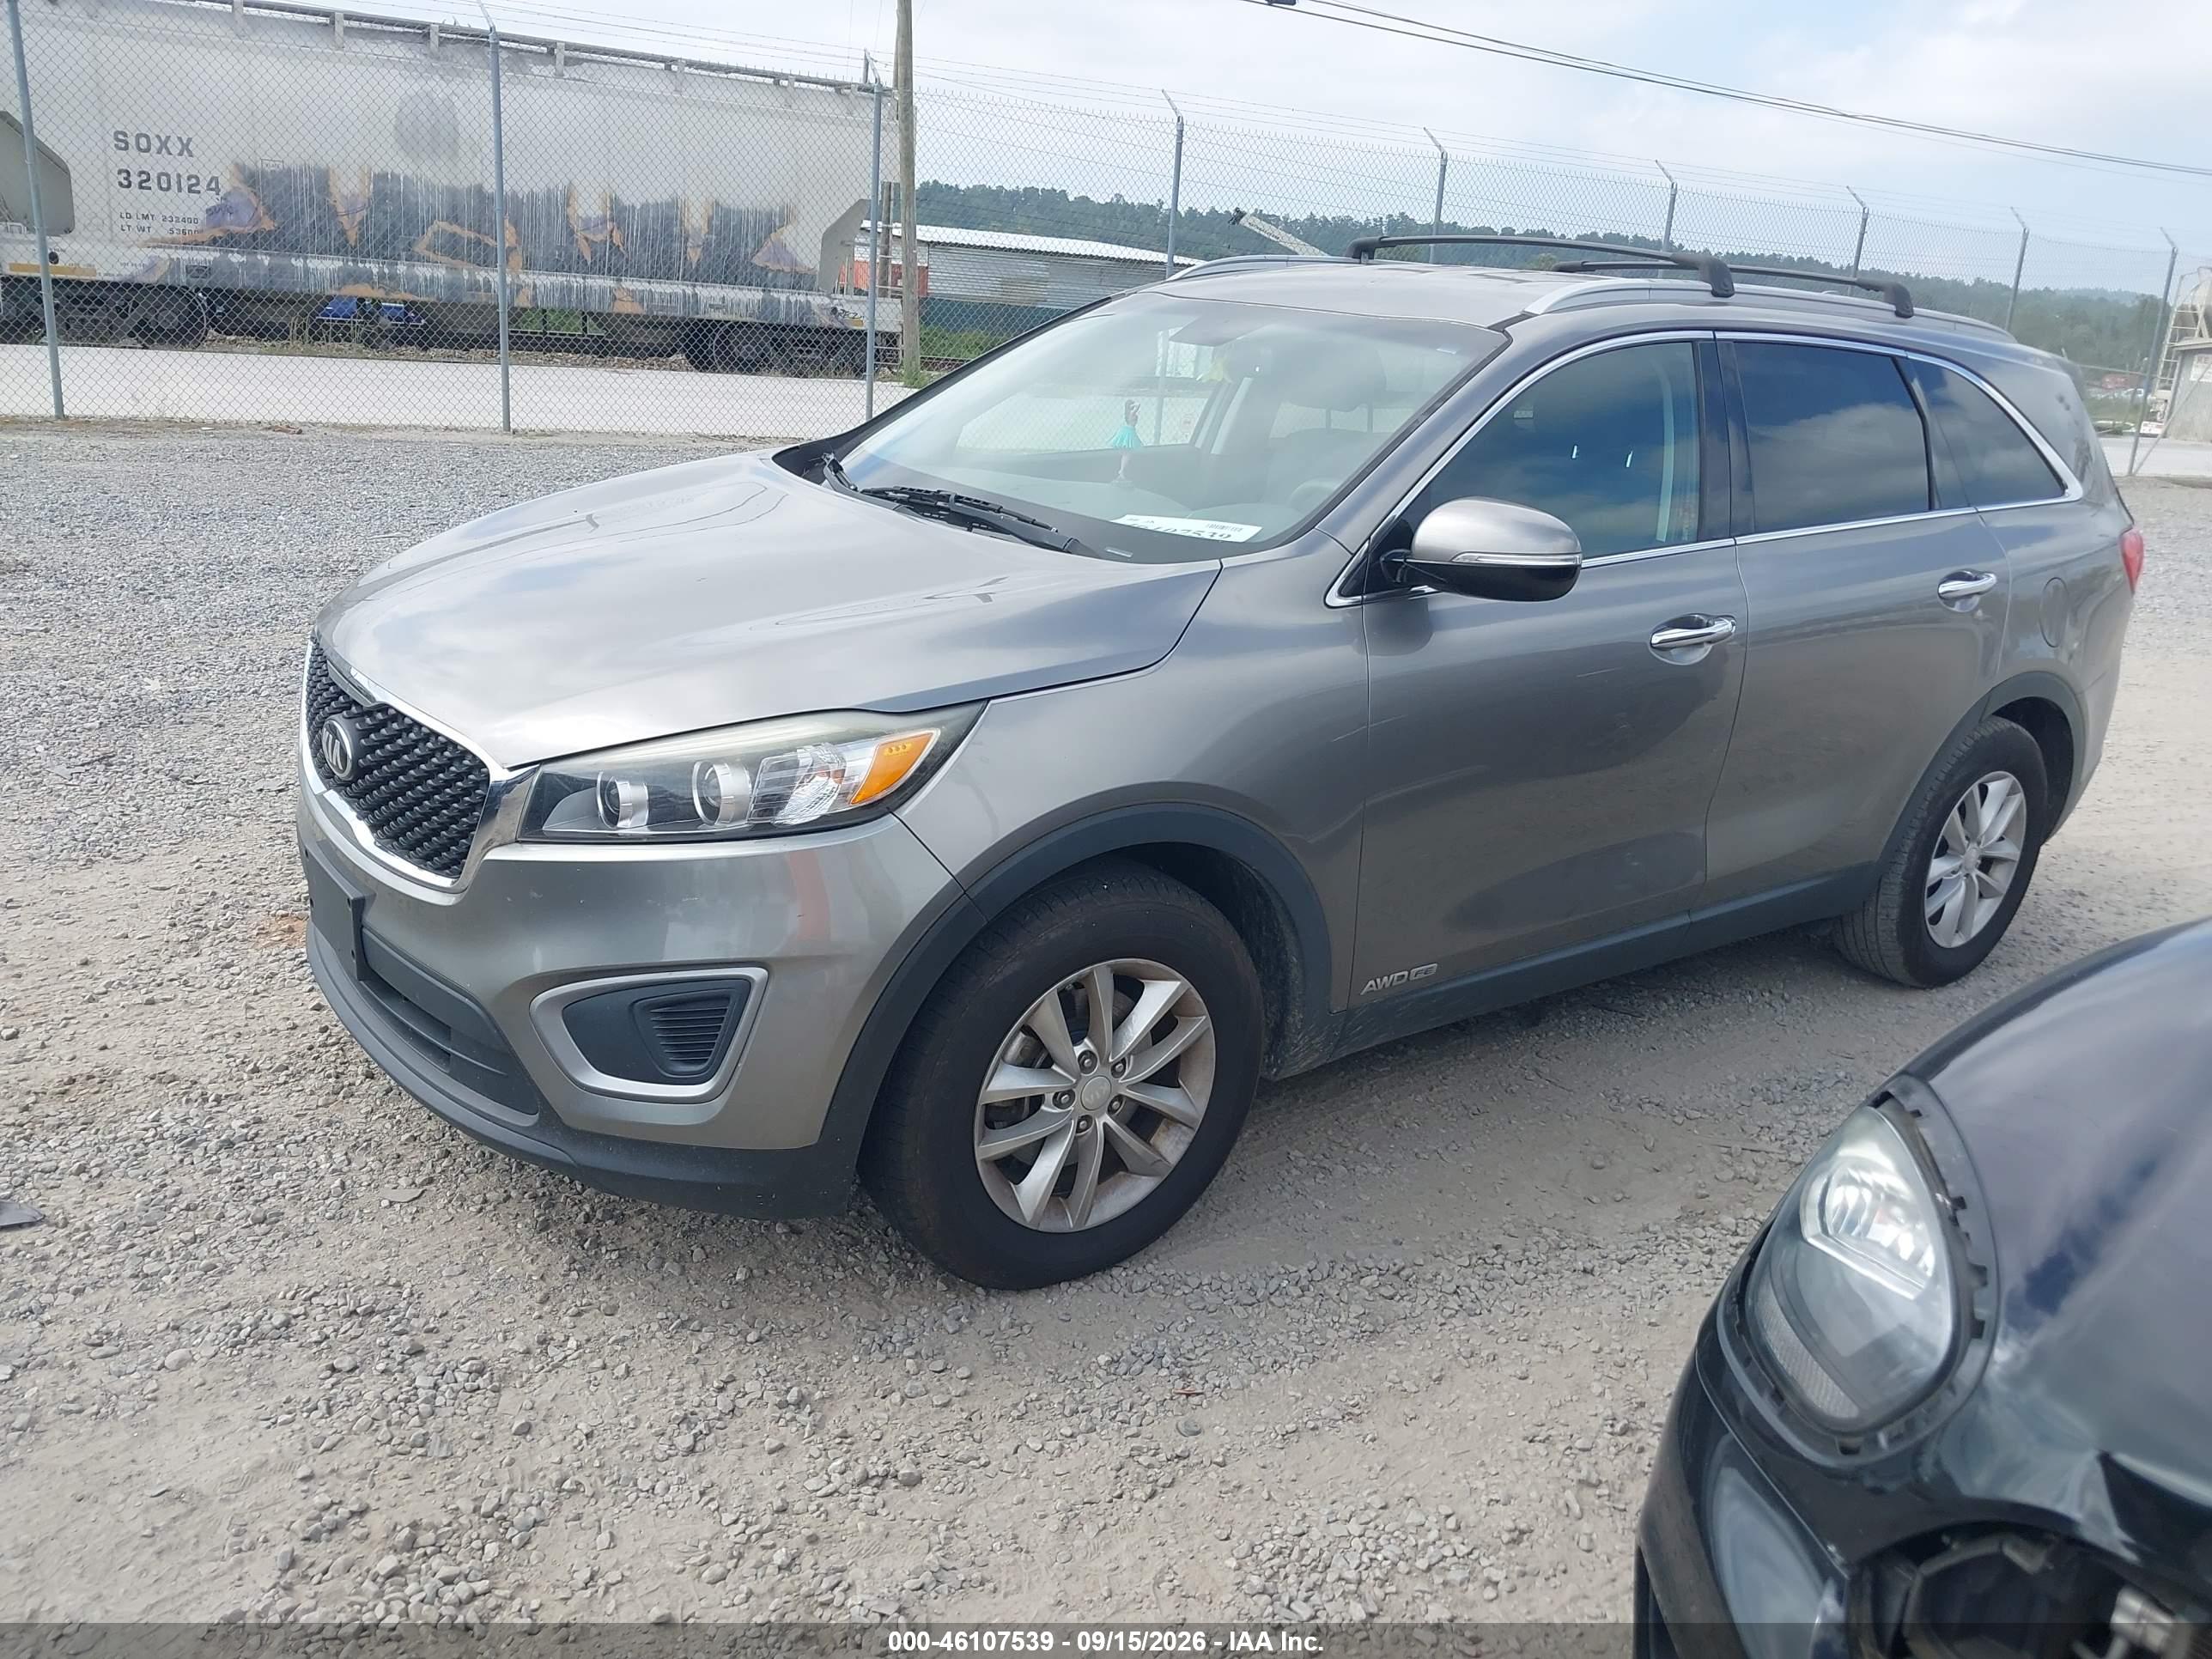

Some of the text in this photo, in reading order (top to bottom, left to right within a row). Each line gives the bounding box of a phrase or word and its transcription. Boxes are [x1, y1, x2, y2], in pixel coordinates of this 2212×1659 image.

[112, 130, 194, 158] SOXX
[117, 168, 222, 196] 320124
[137, 225, 152, 234] WT
[1359, 970, 1409, 996] AWD
